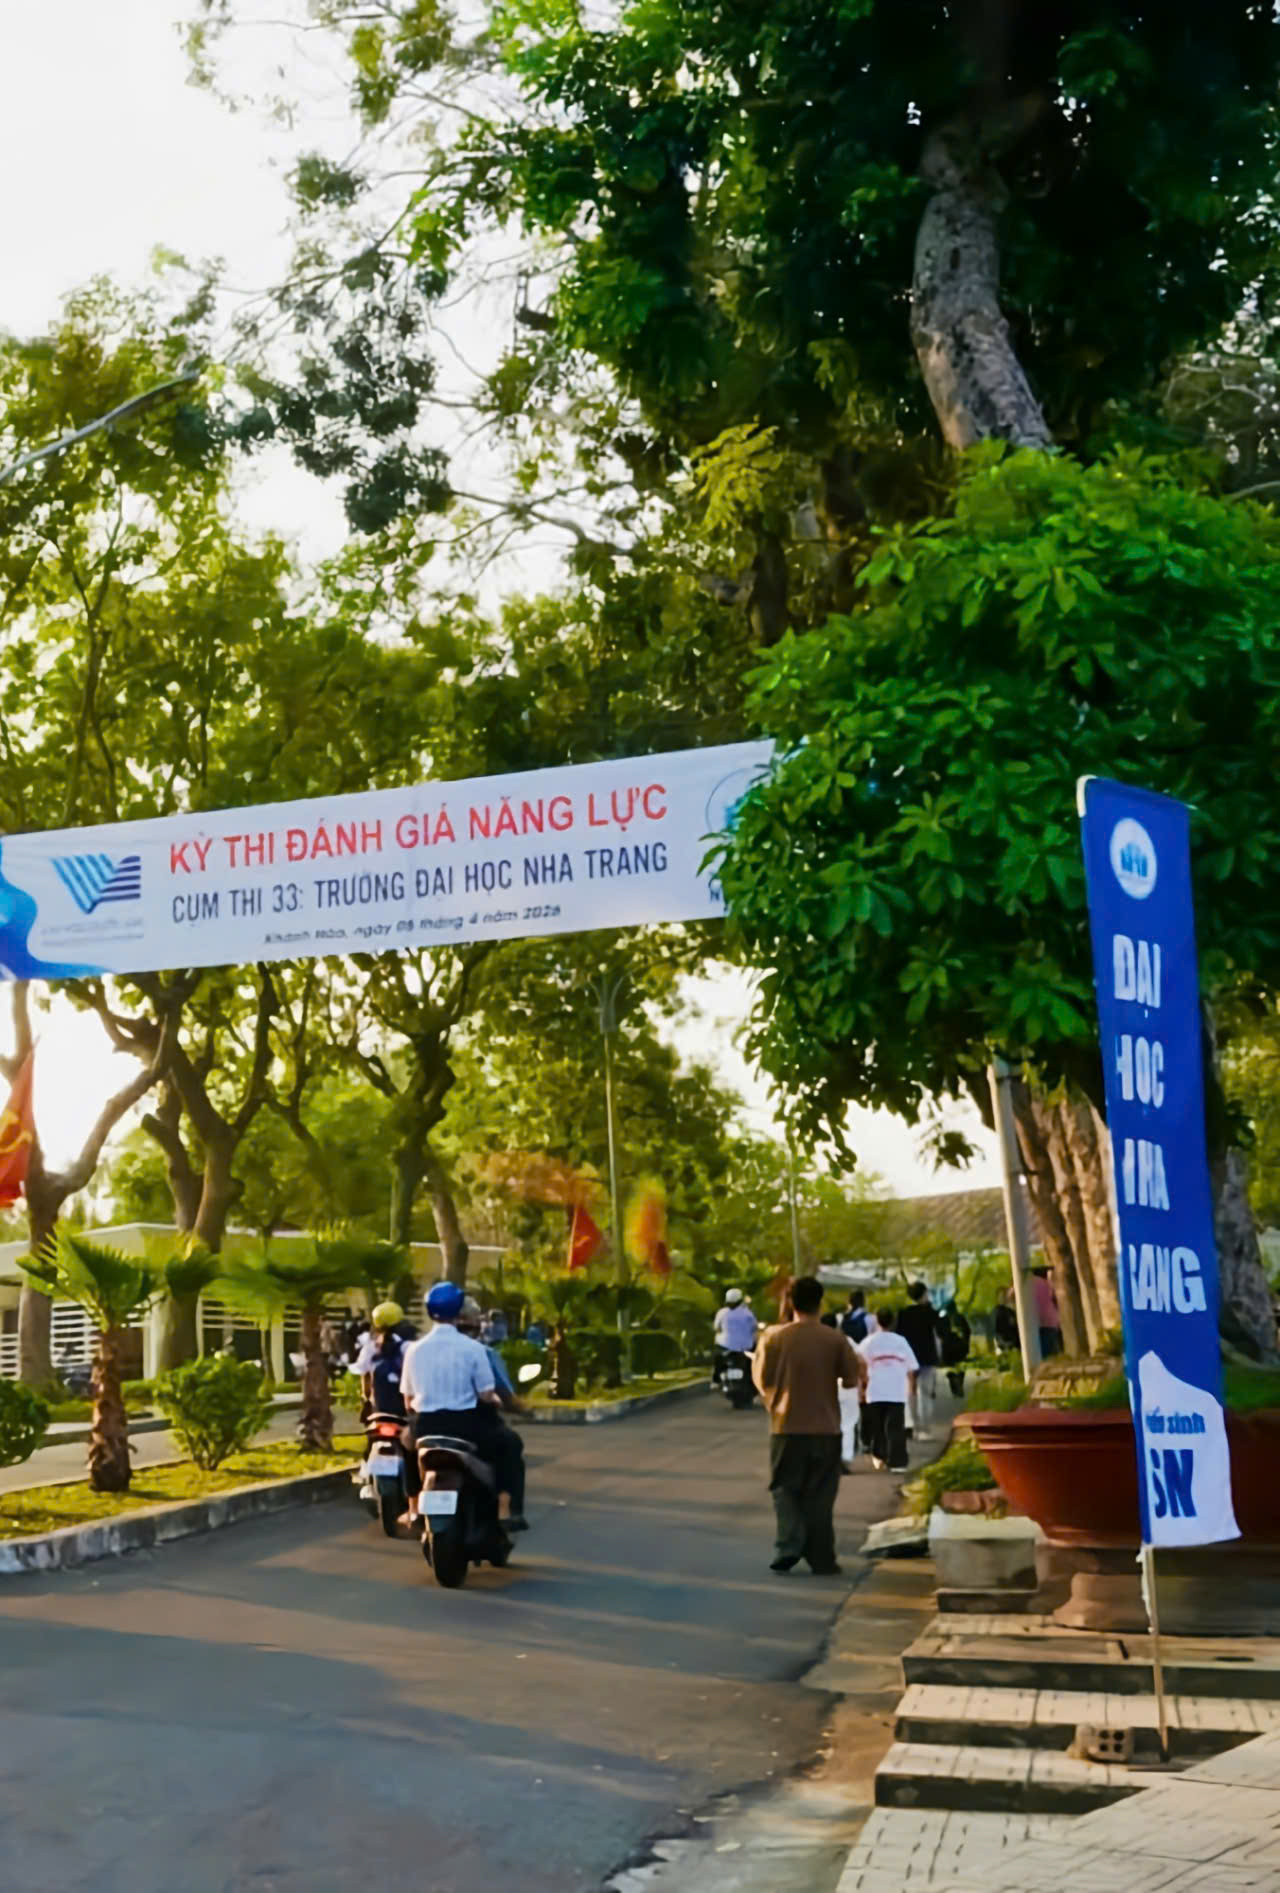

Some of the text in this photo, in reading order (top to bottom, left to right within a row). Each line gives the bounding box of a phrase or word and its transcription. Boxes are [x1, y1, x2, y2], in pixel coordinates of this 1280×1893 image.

[223, 832, 274, 868] THI
[285, 817, 382, 862] ĐÁNH
[396, 803, 456, 849] GIÁ
[469, 796, 574, 840] NĂNG
[588, 784, 667, 832] LỰC
[229, 887, 262, 917] THI
[272, 883, 304, 913] 33:
[465, 860, 513, 895] HỌC
[523, 853, 573, 887] NHA
[584, 842, 668, 879] TRANG
